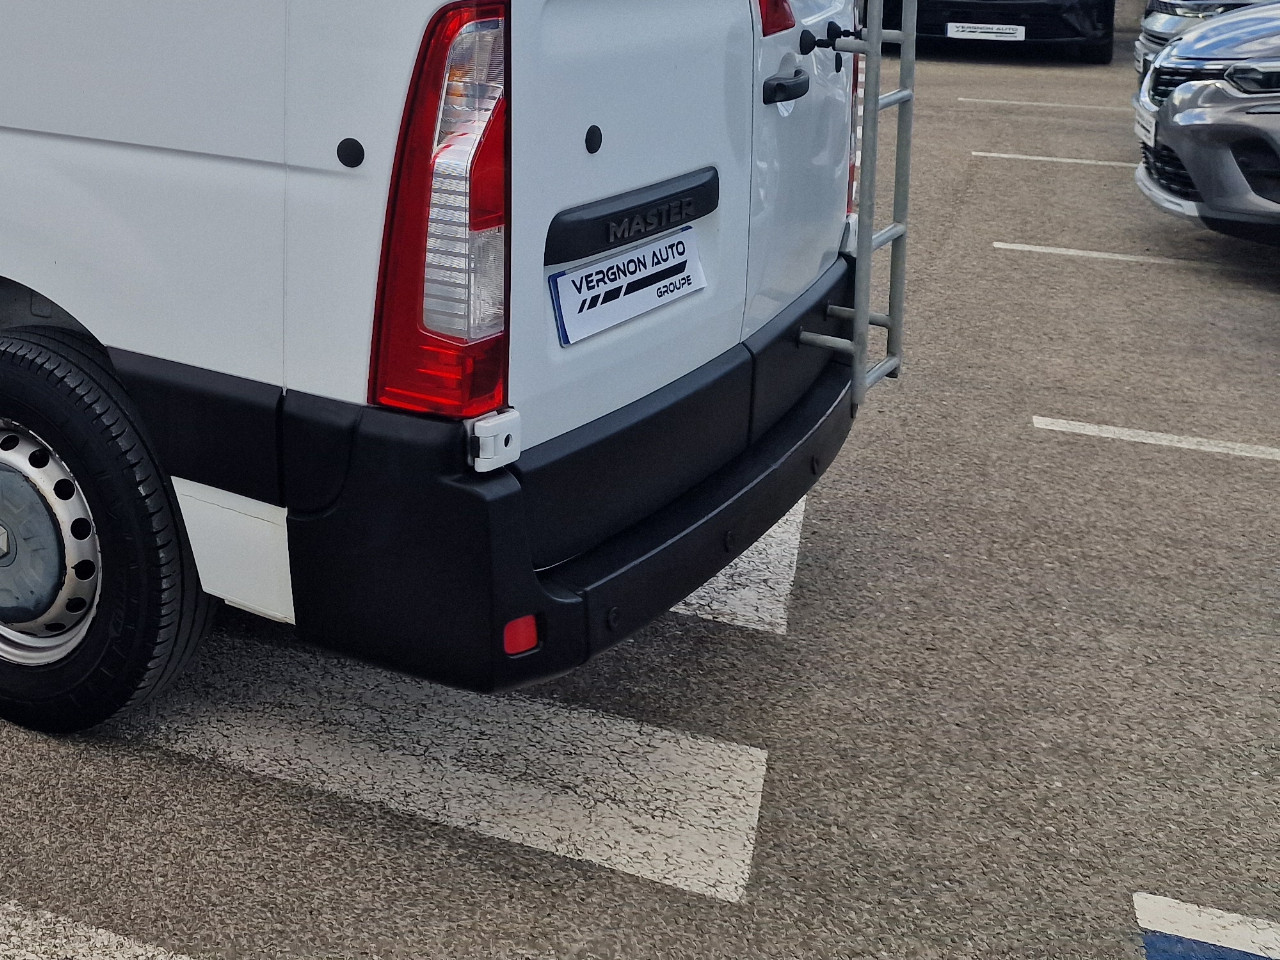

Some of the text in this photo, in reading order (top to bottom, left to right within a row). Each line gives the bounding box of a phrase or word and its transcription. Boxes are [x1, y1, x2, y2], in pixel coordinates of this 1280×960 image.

[609, 197, 696, 243] MASTER
[571, 240, 686, 294] VERGNON AUTO
[656, 275, 692, 298] GROUPE
